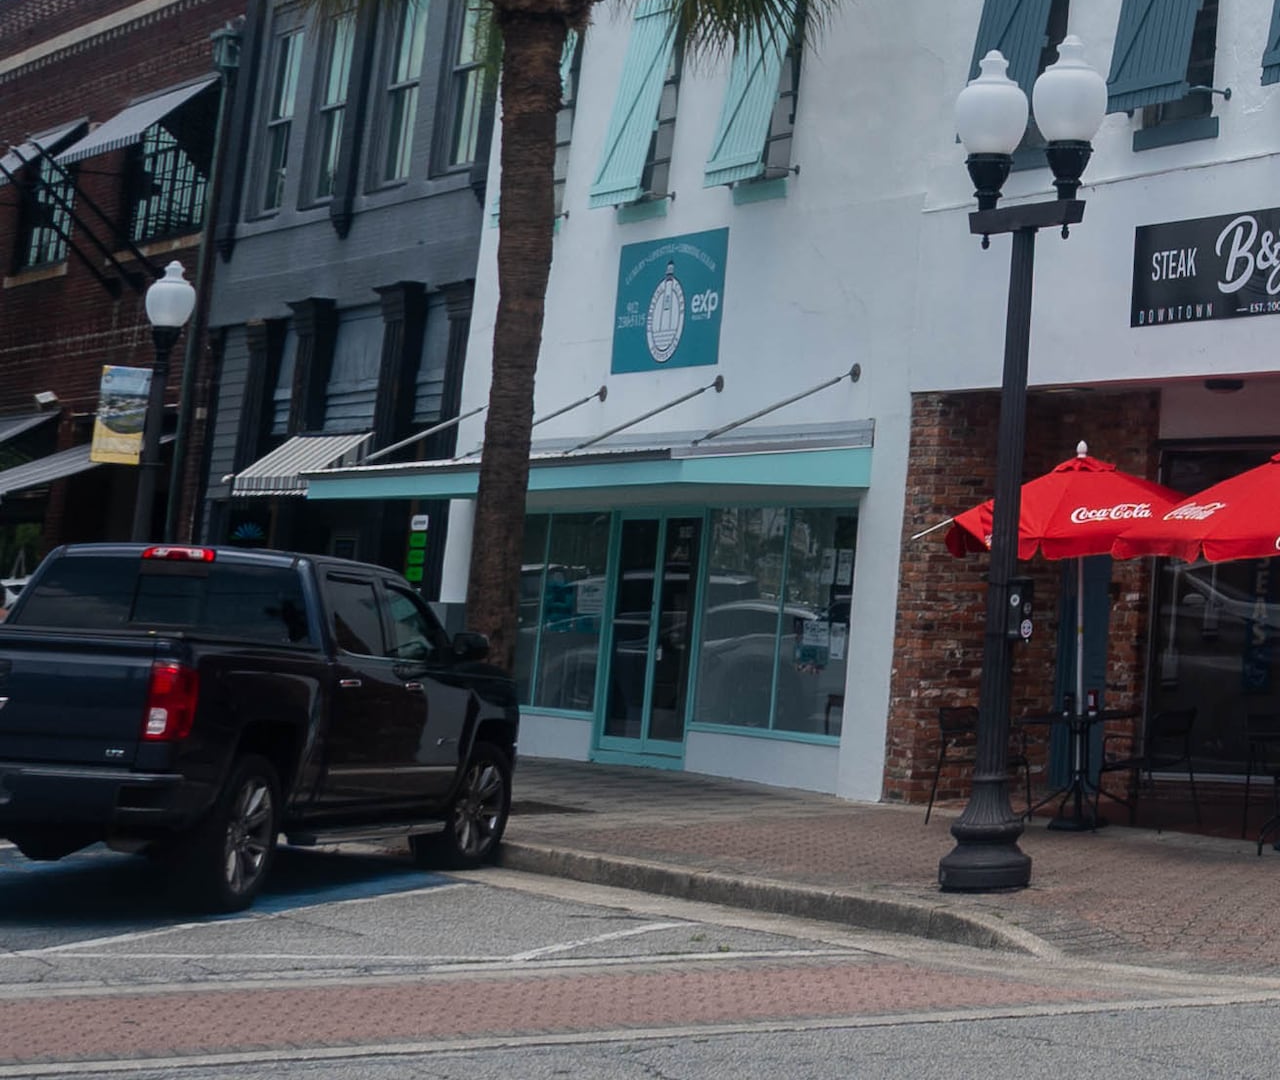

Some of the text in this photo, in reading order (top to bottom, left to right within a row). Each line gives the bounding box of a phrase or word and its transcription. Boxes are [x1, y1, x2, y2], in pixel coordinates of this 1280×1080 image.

[1152, 247, 1197, 281] STEAK
[1139, 303, 1214, 325] DOWNTOWN
[1250, 303, 1265, 314] EST.
[1071, 503, 1151, 523] Coca-Cola
